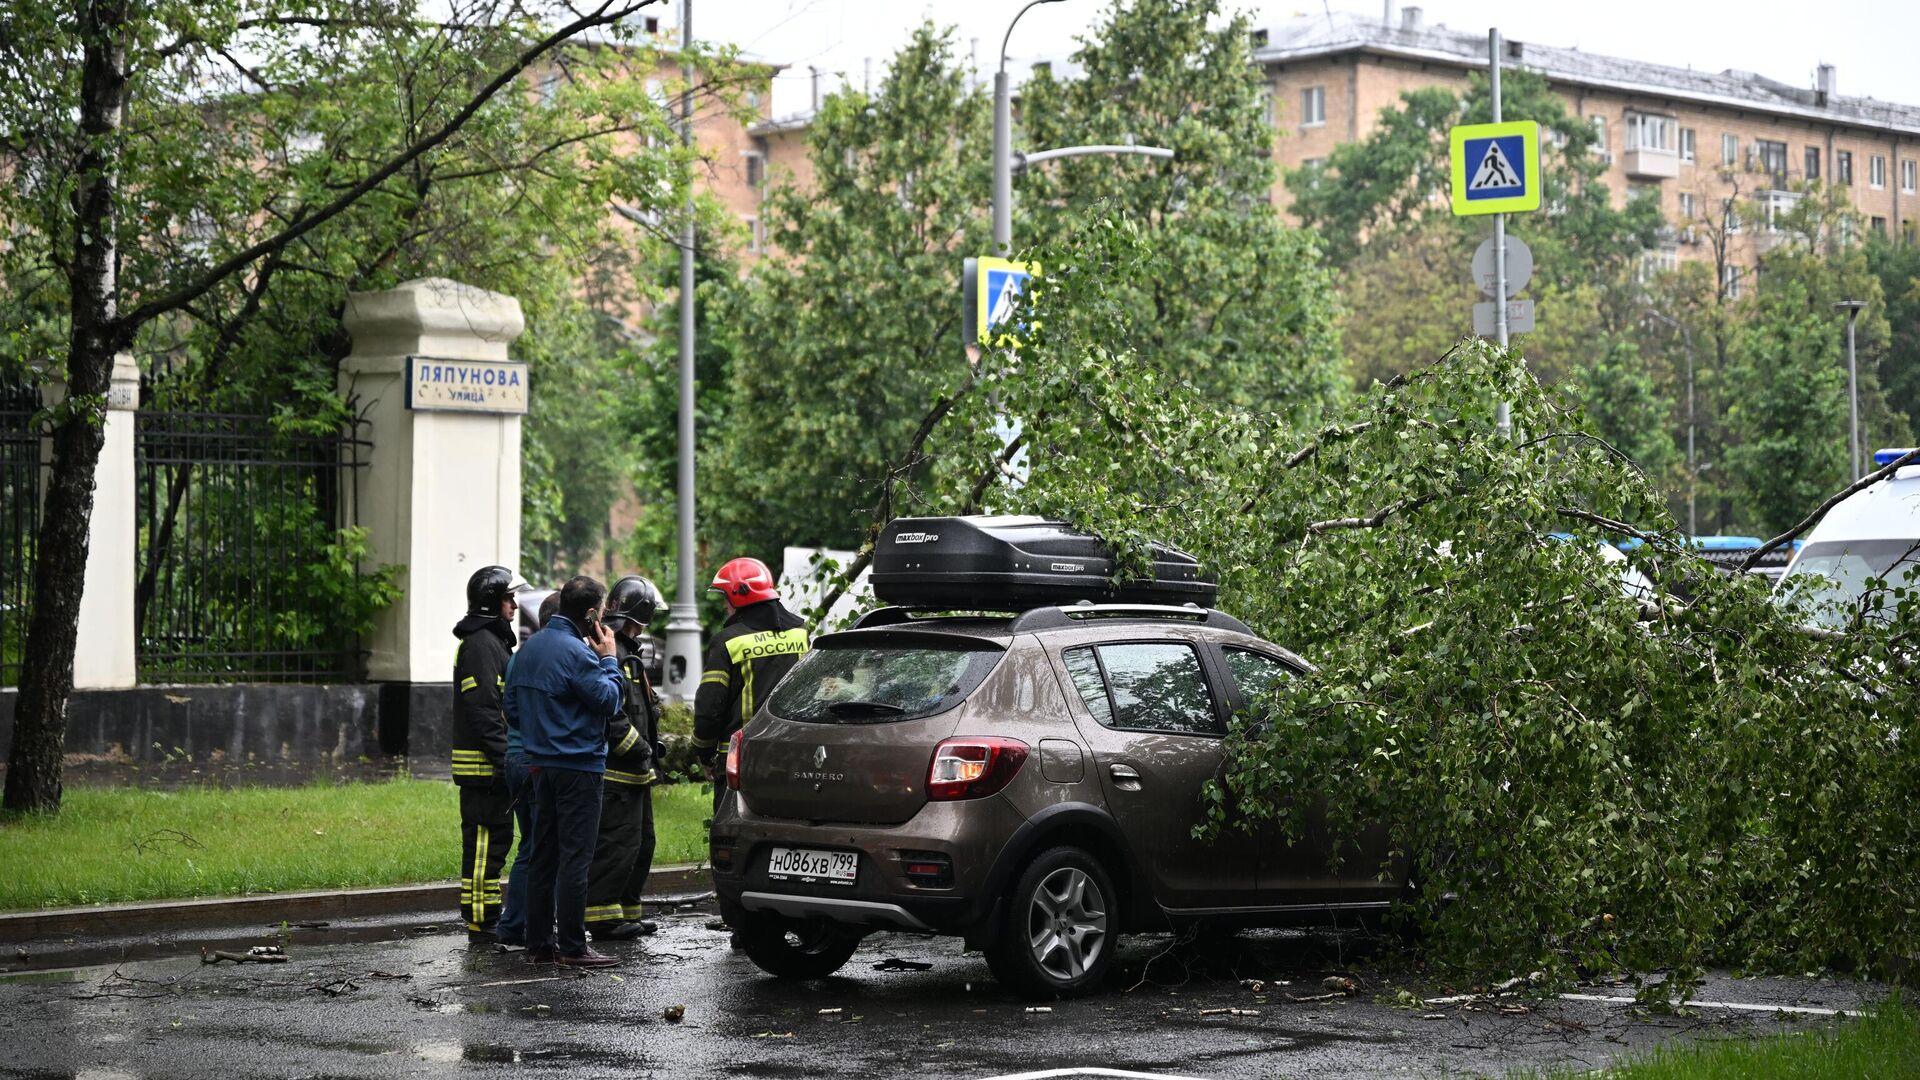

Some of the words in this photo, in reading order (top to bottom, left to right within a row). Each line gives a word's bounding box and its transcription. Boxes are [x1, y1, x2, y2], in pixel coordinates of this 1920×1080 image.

[420, 366, 519, 386] ЛЯПУНОВА
[754, 631, 787, 643] МЧС
[742, 641, 804, 659] РОССИИ
[793, 771, 844, 781] SANDERO
[832, 853, 854, 870] 799
[836, 869, 847, 877] RUS
